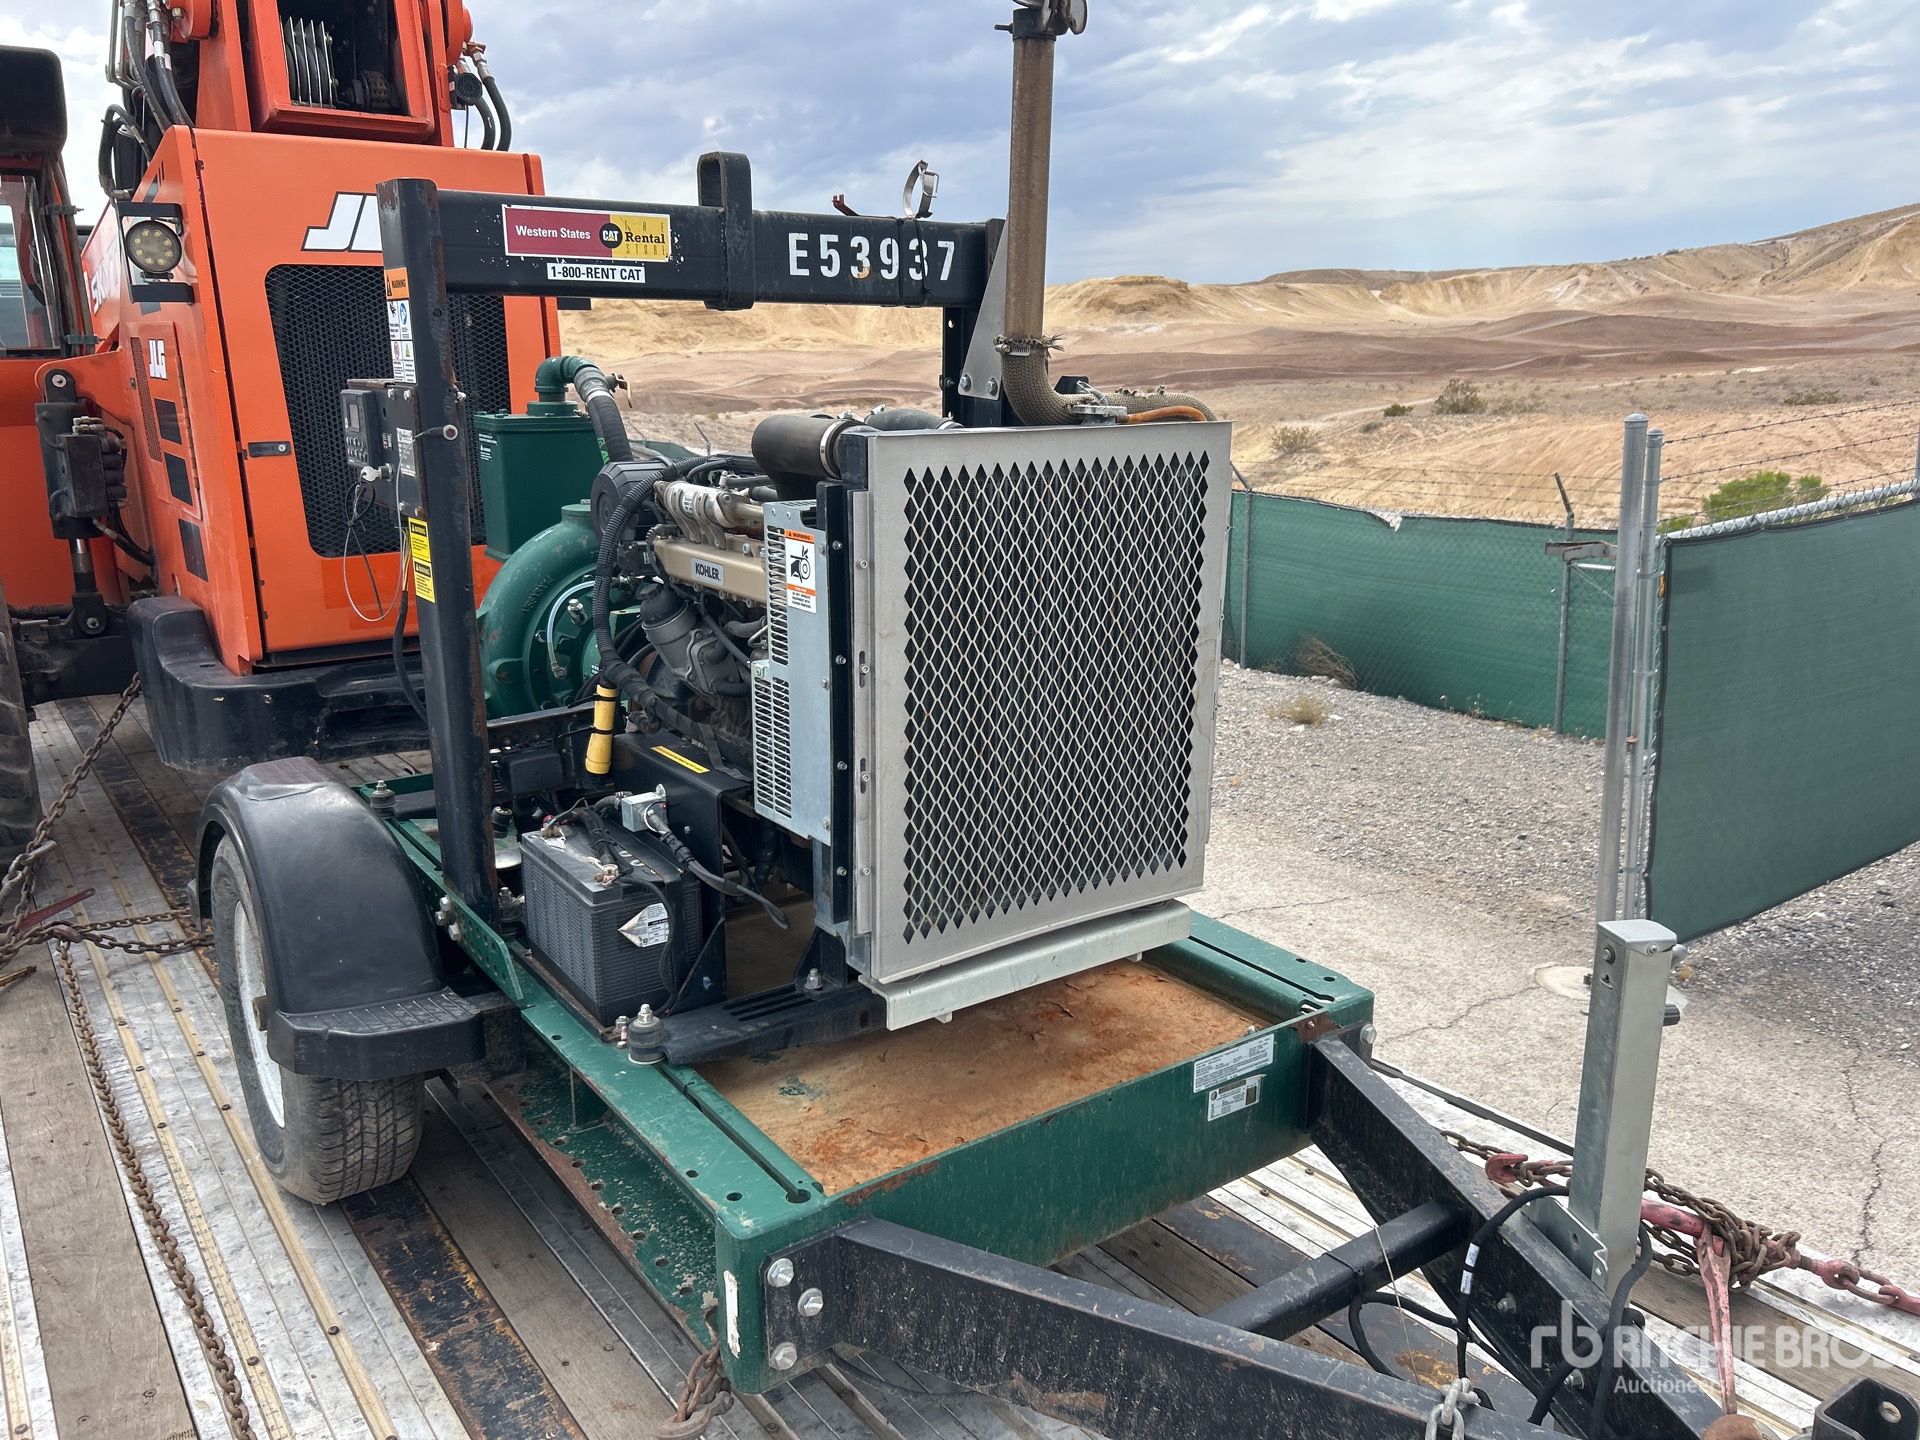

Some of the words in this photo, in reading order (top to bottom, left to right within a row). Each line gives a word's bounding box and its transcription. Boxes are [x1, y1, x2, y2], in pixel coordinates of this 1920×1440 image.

[515, 225, 558, 238] Western
[560, 227, 591, 240] States
[602, 229, 619, 242] CAT
[624, 231, 666, 244] Rental
[788, 232, 955, 281] E53937
[551, 265, 616, 280] 1-800-RENT
[619, 268, 642, 281] CAT
[149, 339, 168, 380] JLG
[695, 562, 721, 581] KOHLER
